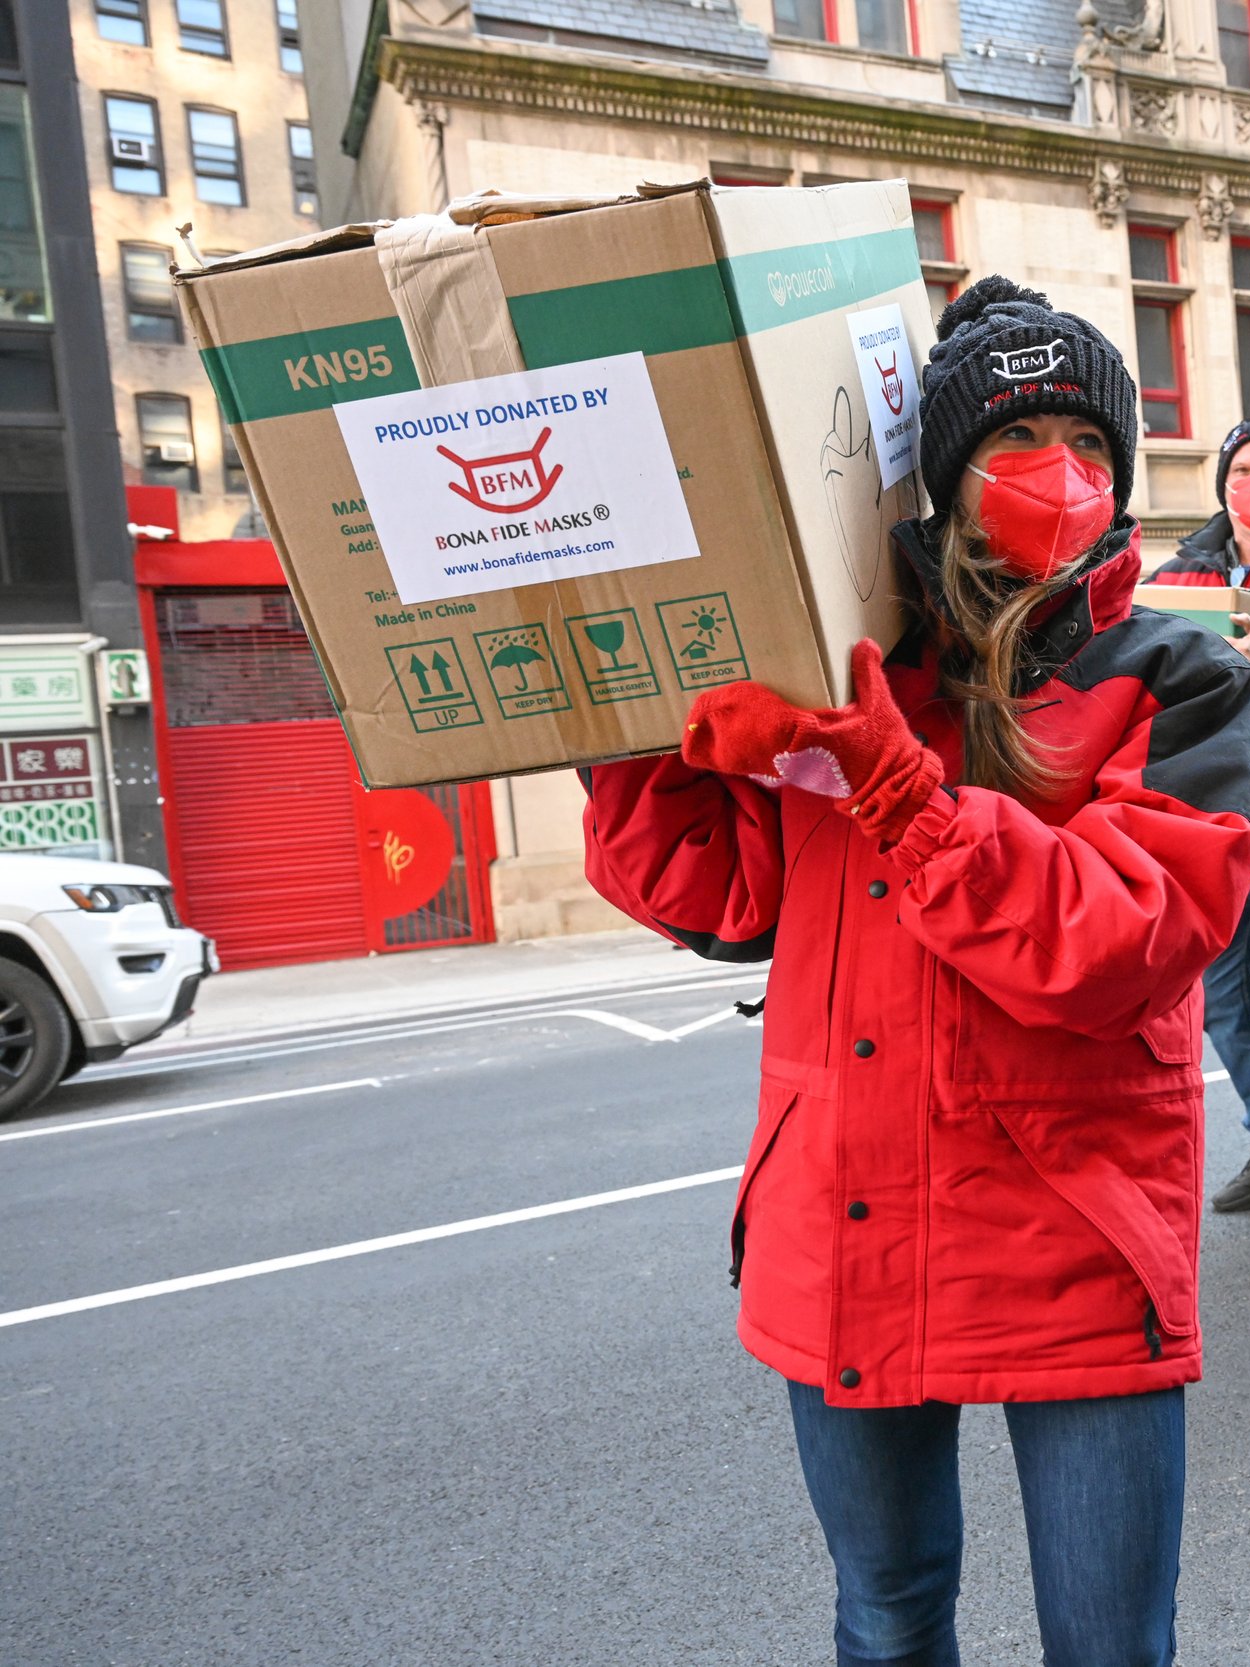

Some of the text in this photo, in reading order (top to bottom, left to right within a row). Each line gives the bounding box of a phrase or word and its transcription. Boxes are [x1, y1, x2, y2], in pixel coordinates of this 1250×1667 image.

[784, 266, 835, 300] POWECOM
[283, 345, 393, 391] KN95
[1011, 354, 1044, 371] BFM
[984, 382, 1080, 411] BONA FIDE MASKS
[375, 388, 609, 443] PROUDLY DONATED BY
[480, 469, 533, 495] BFM
[340, 523, 376, 536] Guan
[435, 529, 489, 551] BONA
[490, 522, 531, 542] FIDE
[348, 540, 379, 554] Add:
[444, 538, 615, 577] www.bonafidemasks.com
[375, 602, 477, 627] Made in China
[690, 666, 736, 681] KEEP COOL
[595, 680, 653, 696] HANDLE GENTLY
[515, 697, 553, 709] KEEP DRY
[434, 709, 459, 726] UP
